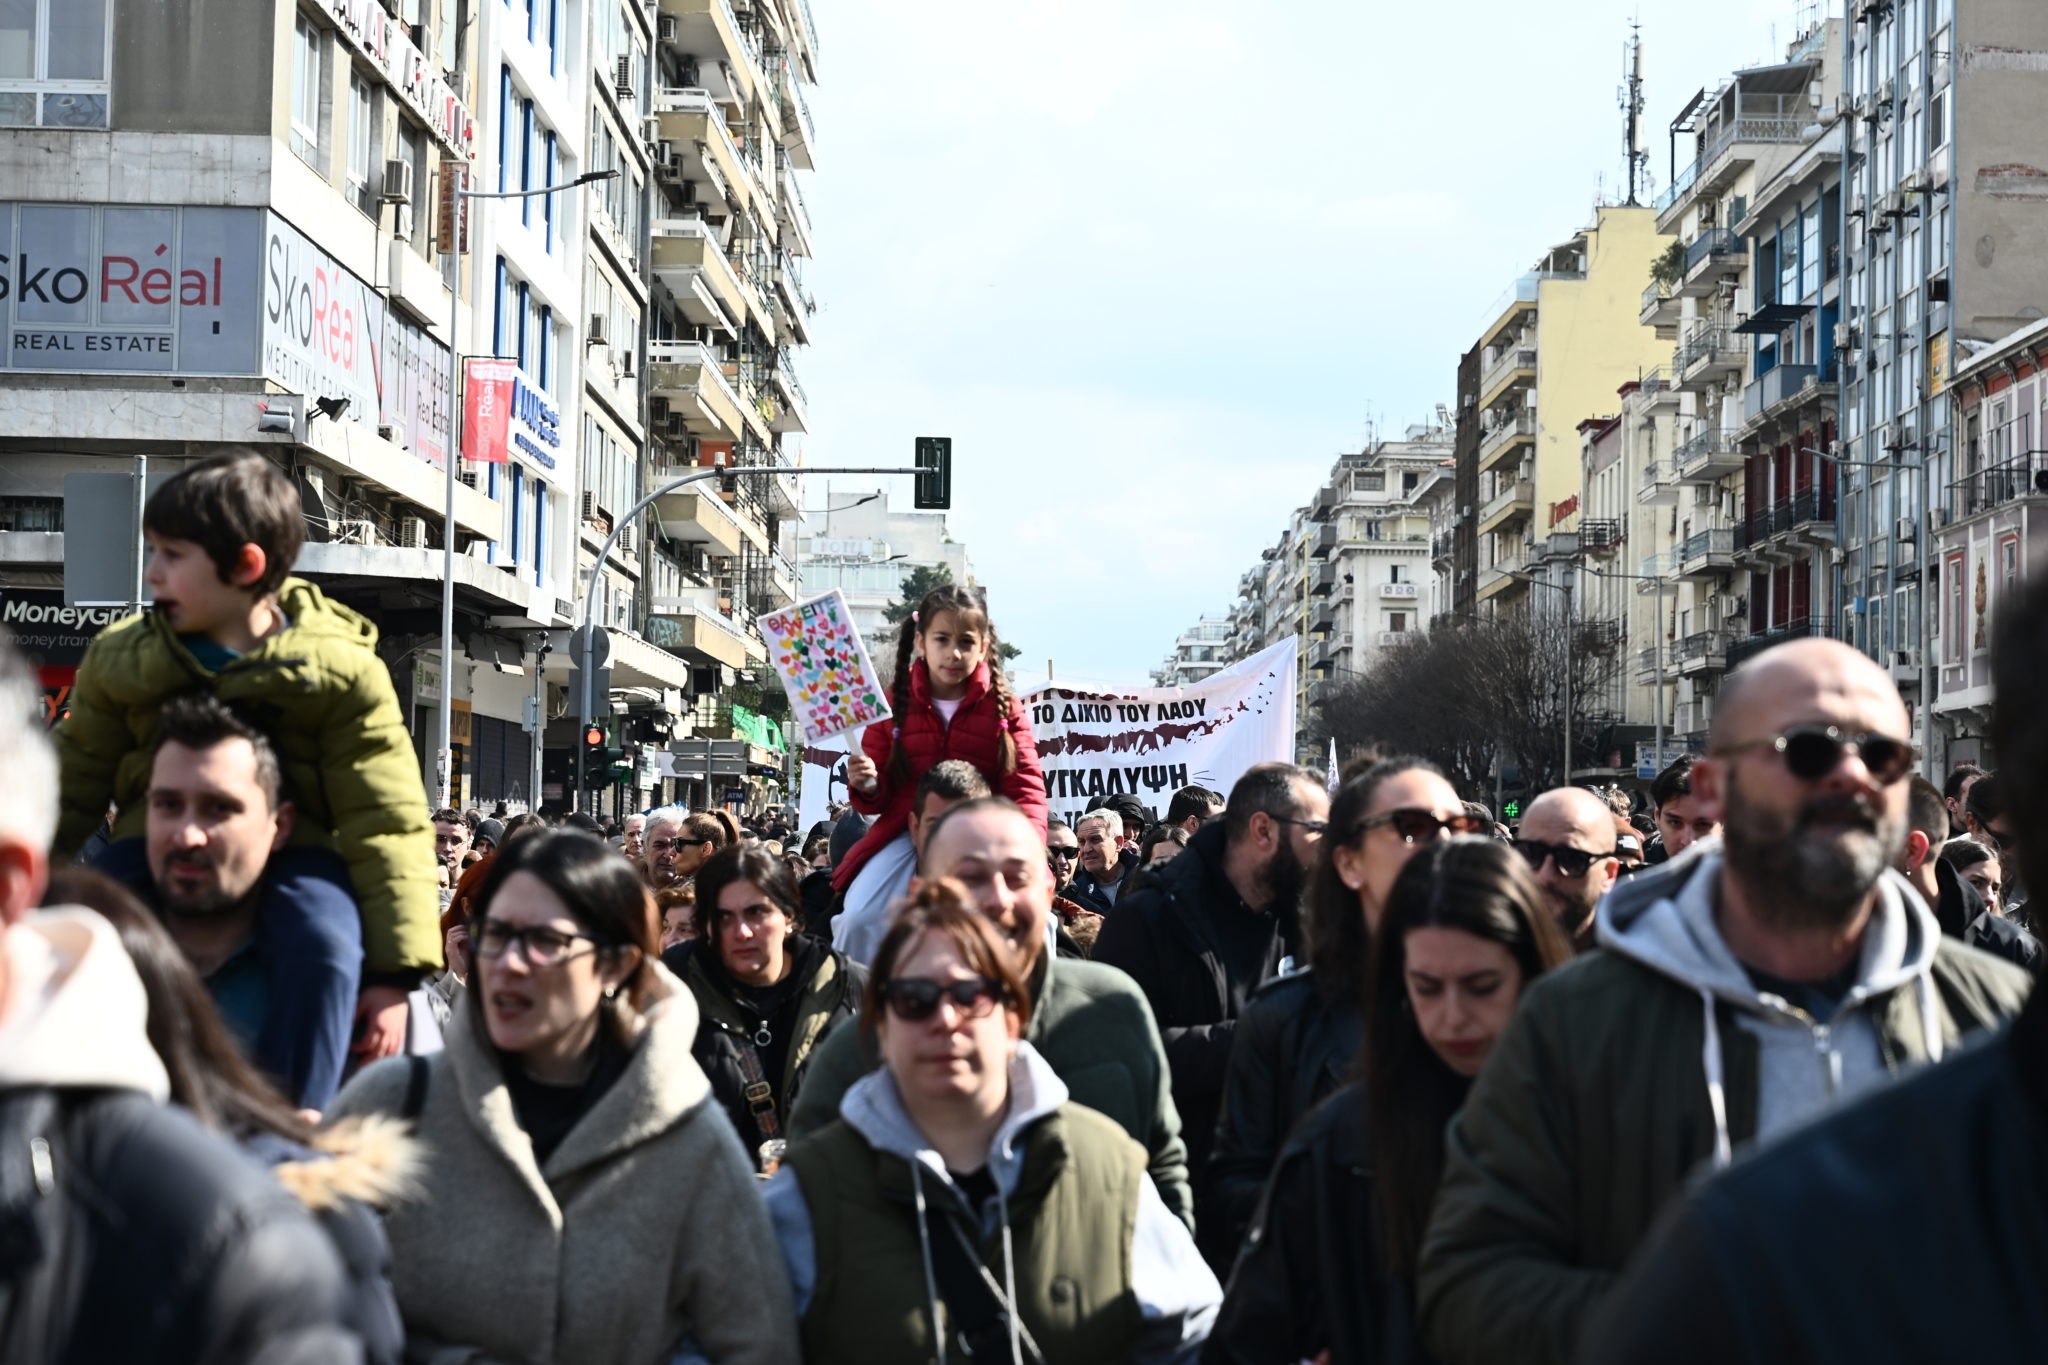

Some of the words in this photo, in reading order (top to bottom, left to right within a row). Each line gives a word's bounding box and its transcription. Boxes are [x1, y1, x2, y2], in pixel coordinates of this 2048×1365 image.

[14, 334, 74, 350] REAL
[86, 335, 171, 353] ESTATE
[1032, 704, 1055, 724] ΤΟ
[1061, 703, 1112, 723] ΔΙΚΙΟ
[1116, 703, 1150, 723] ΤΟΥ
[1157, 698, 1207, 721] ΛΑΟΥ
[1042, 763, 1188, 798] ΥΓΚΑΛΥΨΗ
